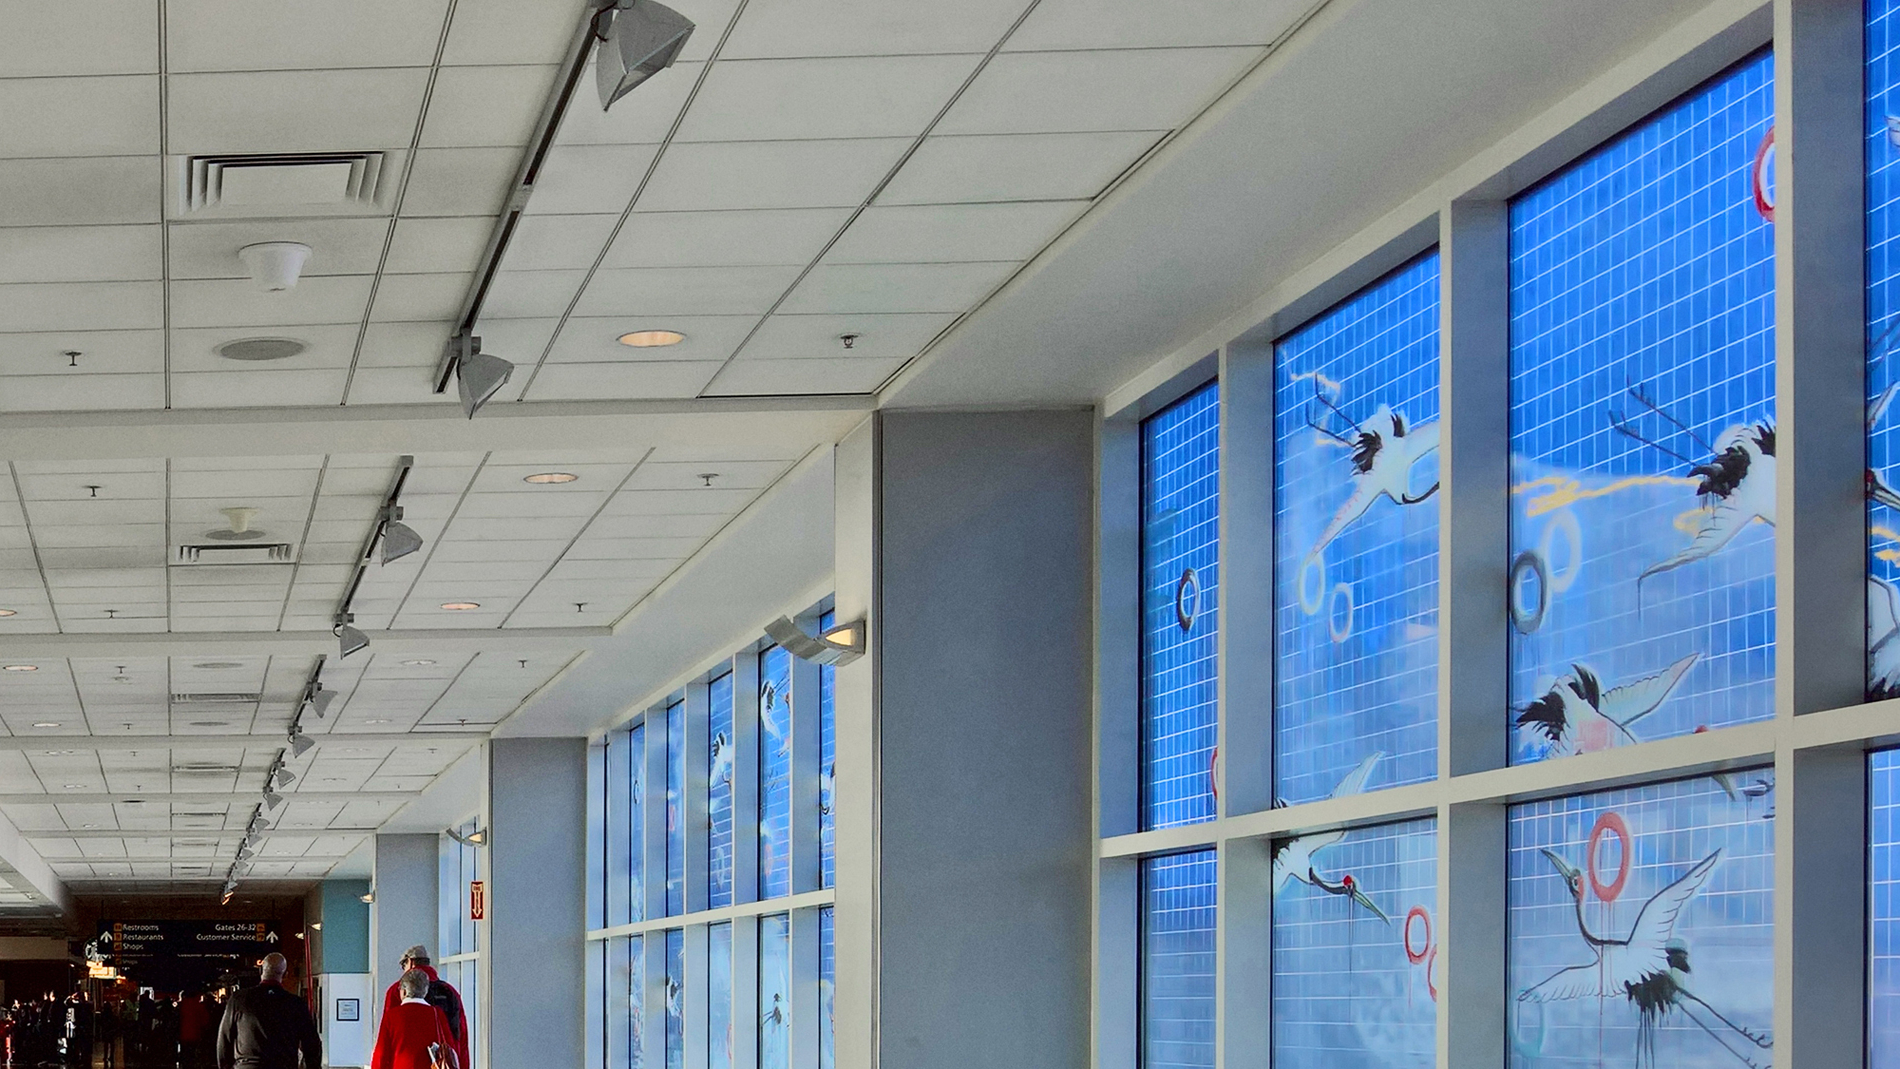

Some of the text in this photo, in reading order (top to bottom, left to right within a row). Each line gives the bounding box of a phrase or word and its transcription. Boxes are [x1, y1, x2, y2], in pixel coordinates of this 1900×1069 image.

[122, 924, 160, 932] Restrooms
[215, 924, 256, 932] Gates 26-32
[122, 933, 164, 941] Restaurants
[196, 933, 256, 941] Customer Service
[122, 943, 144, 951] Shops
